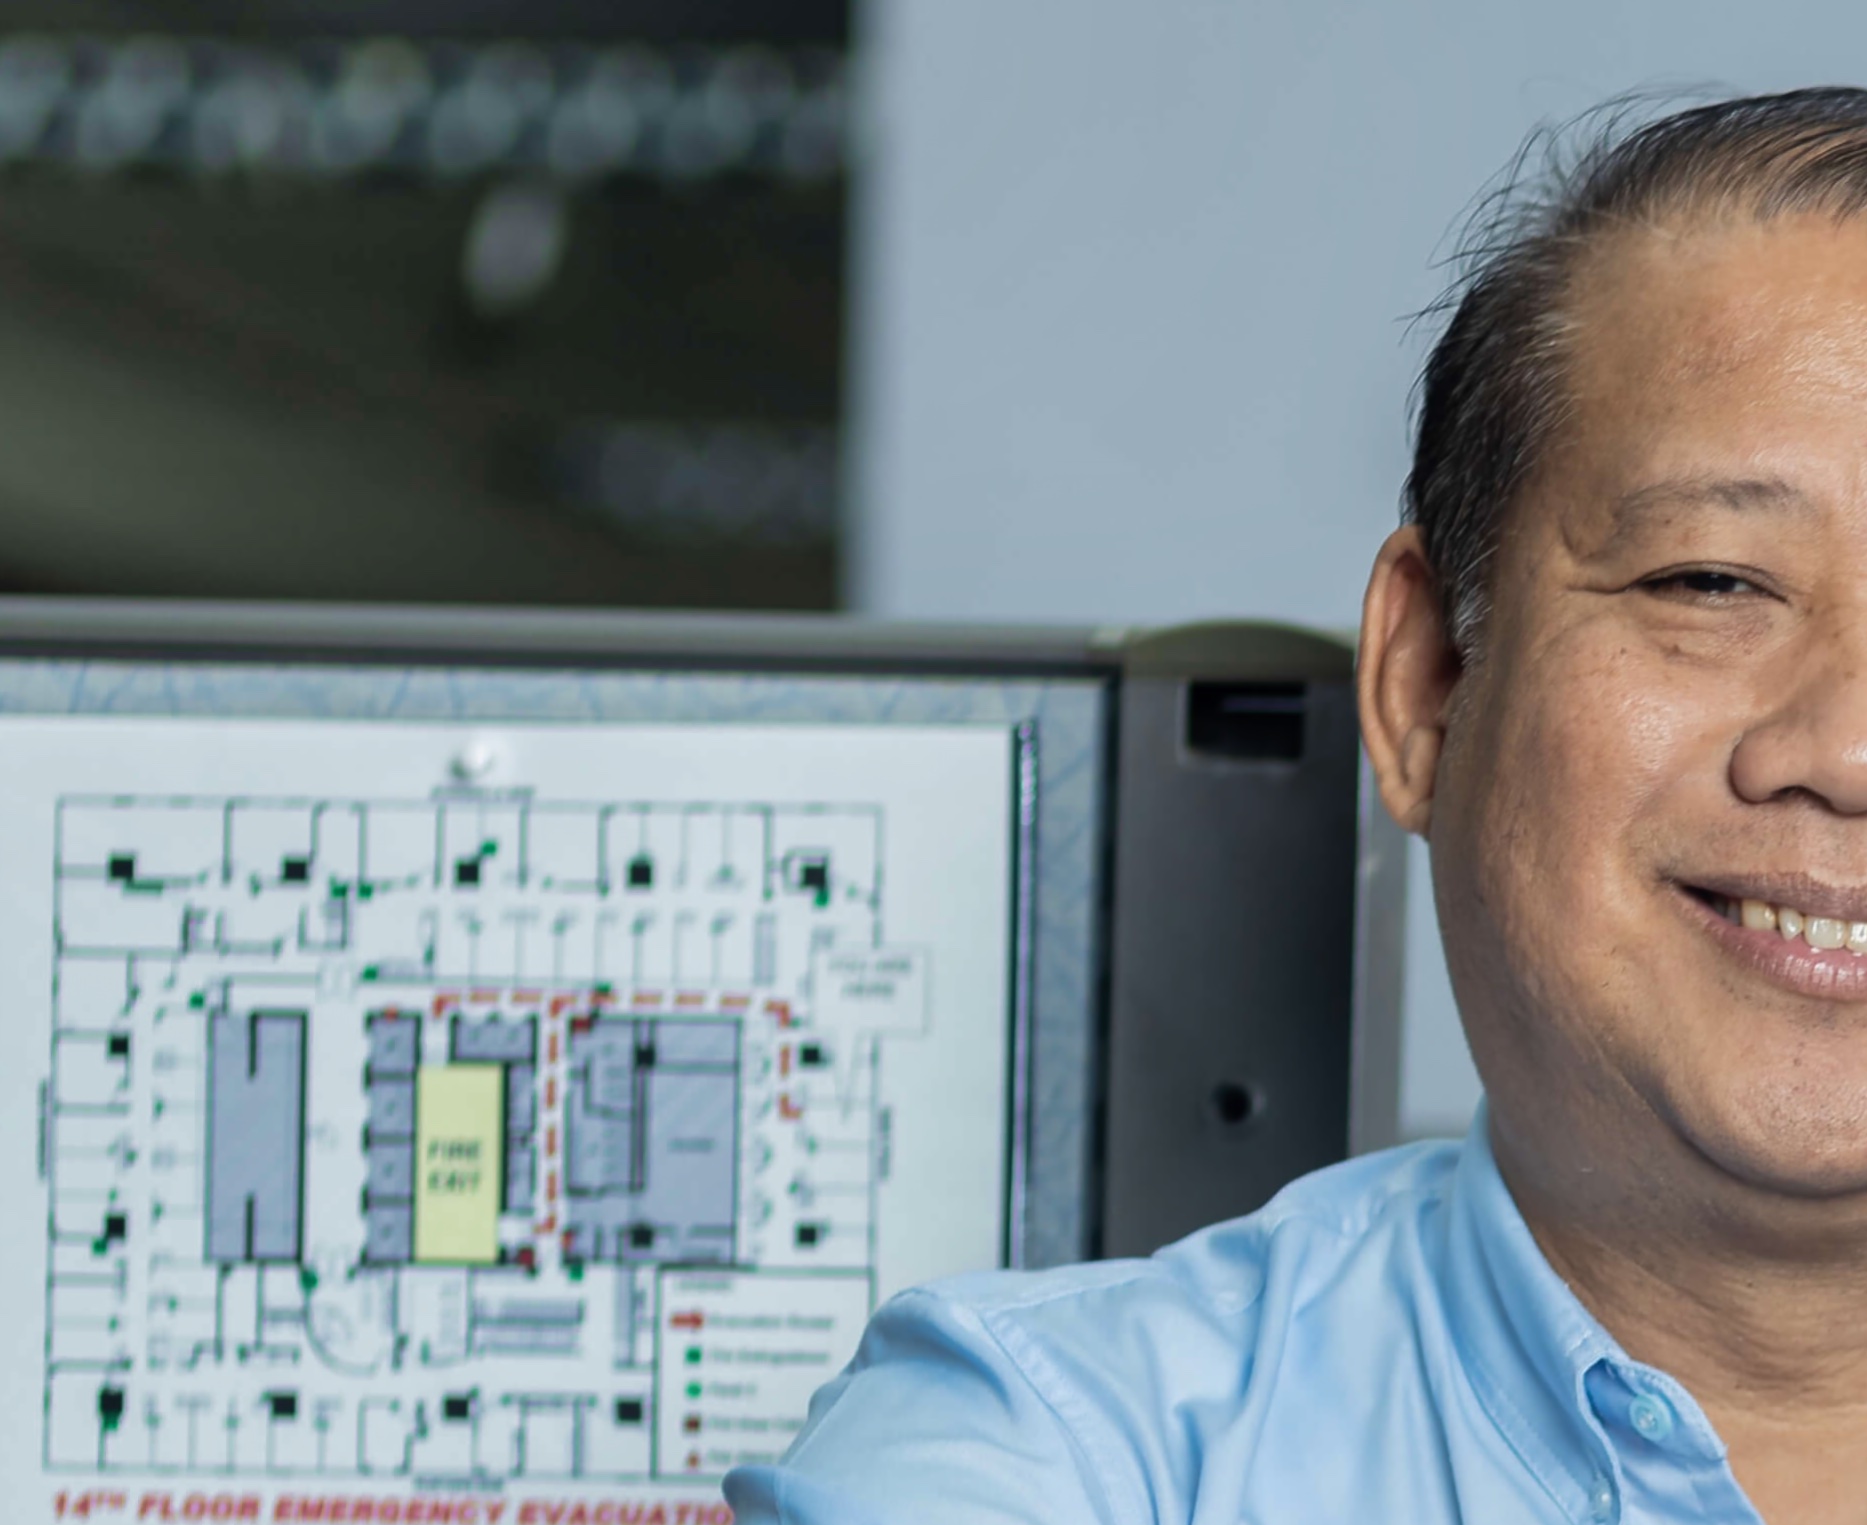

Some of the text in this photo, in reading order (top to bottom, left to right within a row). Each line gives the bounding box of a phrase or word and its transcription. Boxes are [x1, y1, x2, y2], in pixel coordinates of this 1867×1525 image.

[427, 1137, 483, 1161] FIRE
[427, 1169, 481, 1194] EXIT
[138, 1491, 262, 1524] FLOOR
